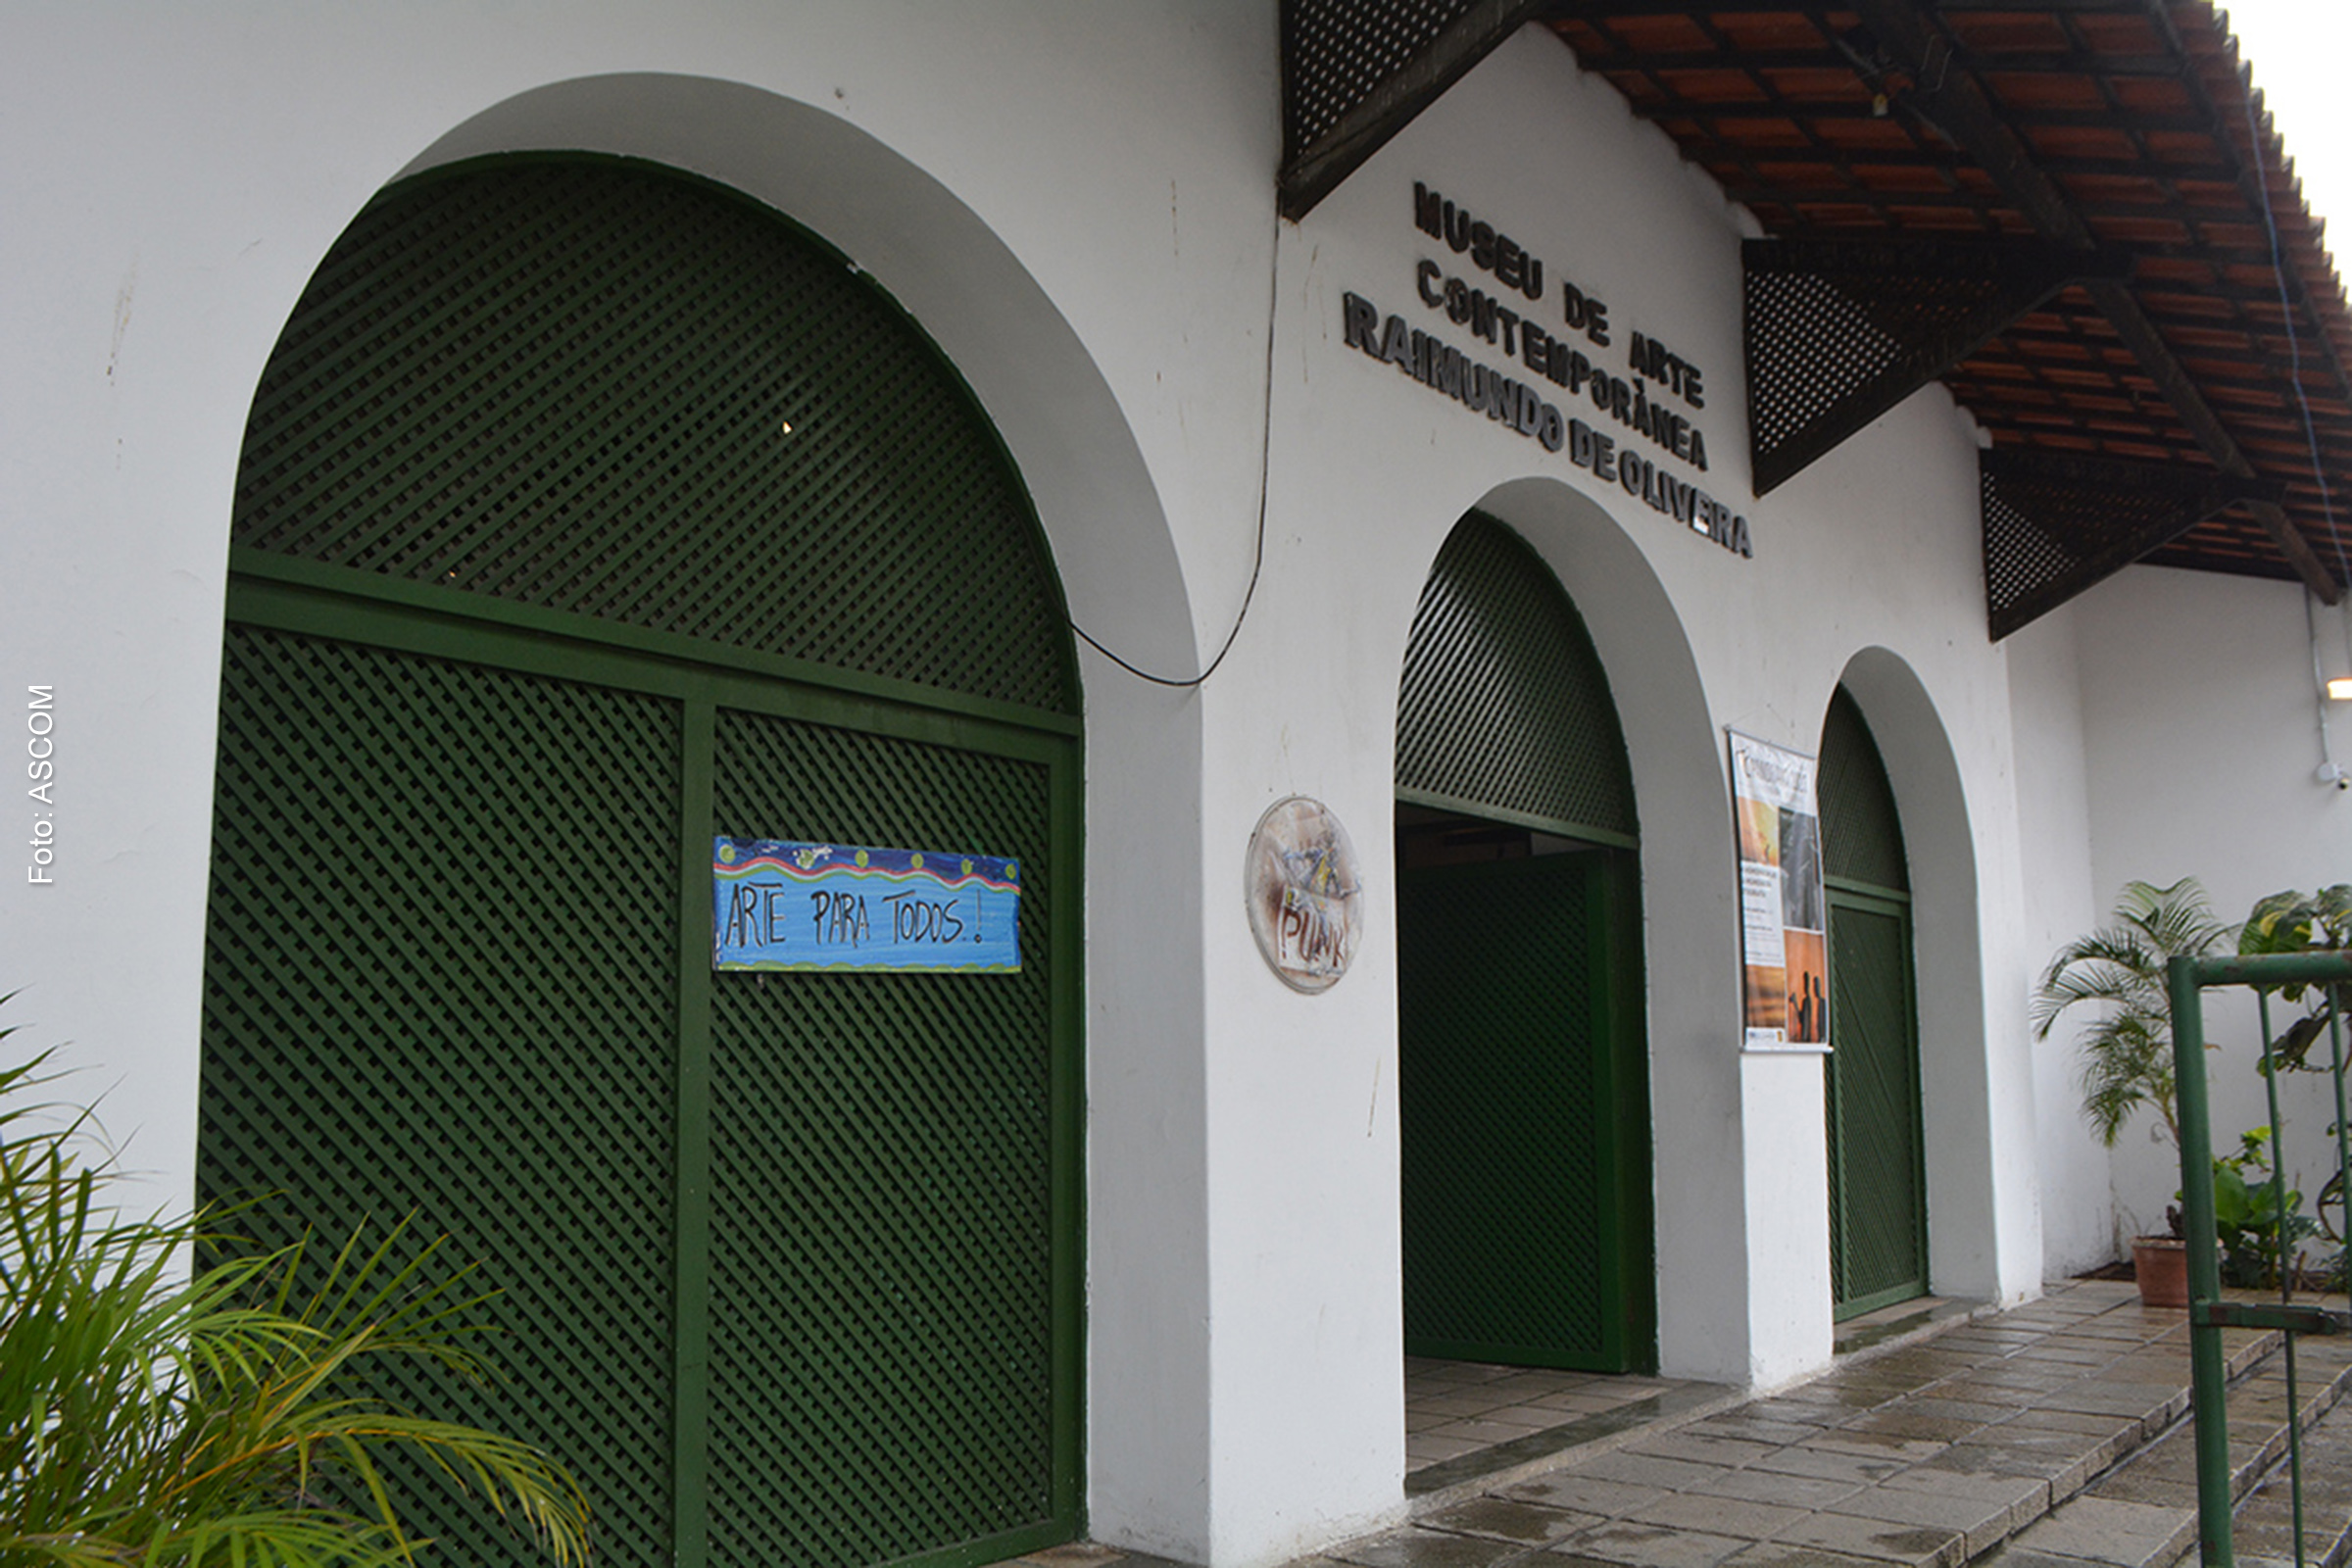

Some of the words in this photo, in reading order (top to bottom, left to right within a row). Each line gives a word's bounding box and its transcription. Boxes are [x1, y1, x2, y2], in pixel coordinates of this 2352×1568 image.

[1414, 180, 1544, 300] MUSEU
[1564, 281, 1610, 348] DE
[1630, 329, 1705, 410] ARTE
[1343, 291, 1565, 453] RAIMUNDO
[1569, 416, 1618, 483] DE
[1620, 449, 1753, 560] OLIVEIRA
[724, 881, 786, 949] ARTE
[810, 890, 870, 949] PARA
